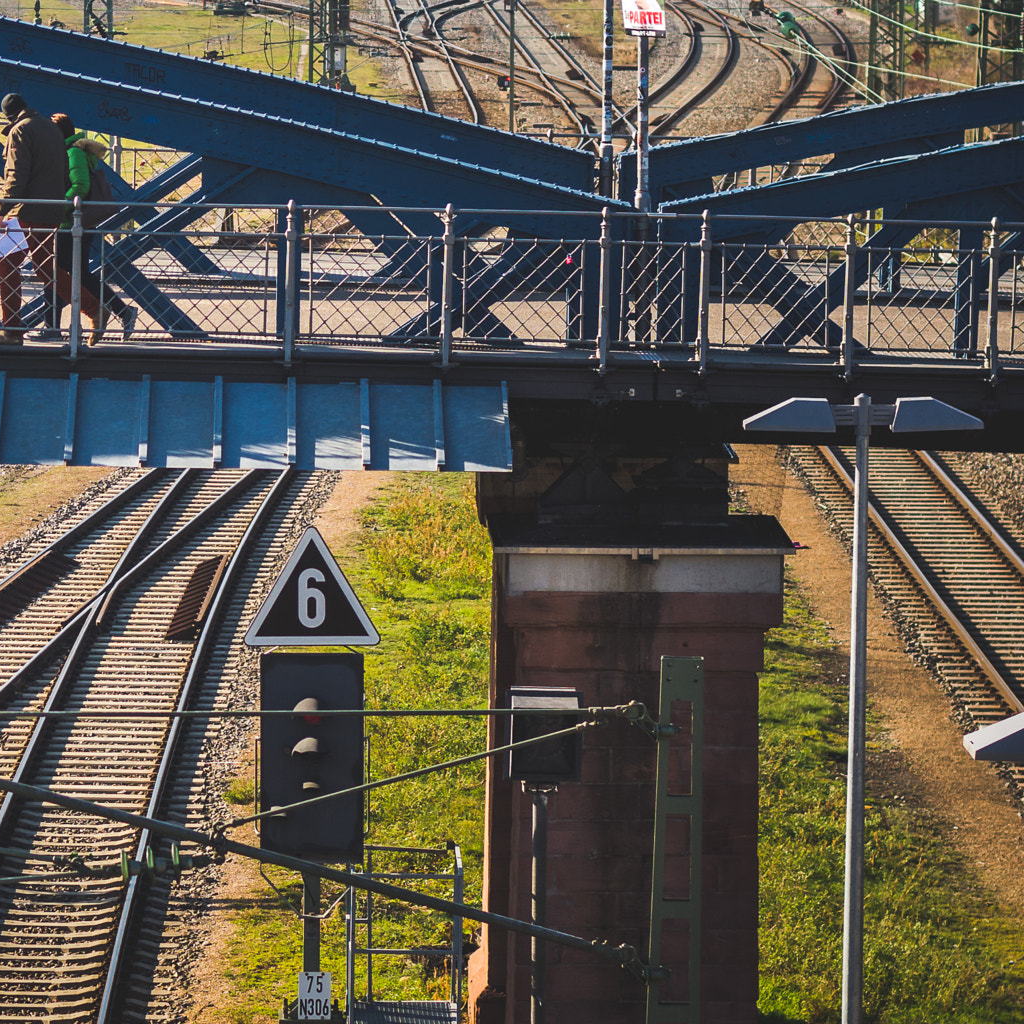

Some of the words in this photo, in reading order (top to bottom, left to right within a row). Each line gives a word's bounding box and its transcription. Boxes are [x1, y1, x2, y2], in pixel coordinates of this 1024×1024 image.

[629, 10, 663, 25] PARTEI
[298, 567, 326, 629] 6
[306, 975, 323, 994] 75
[299, 998, 329, 1016] N306
